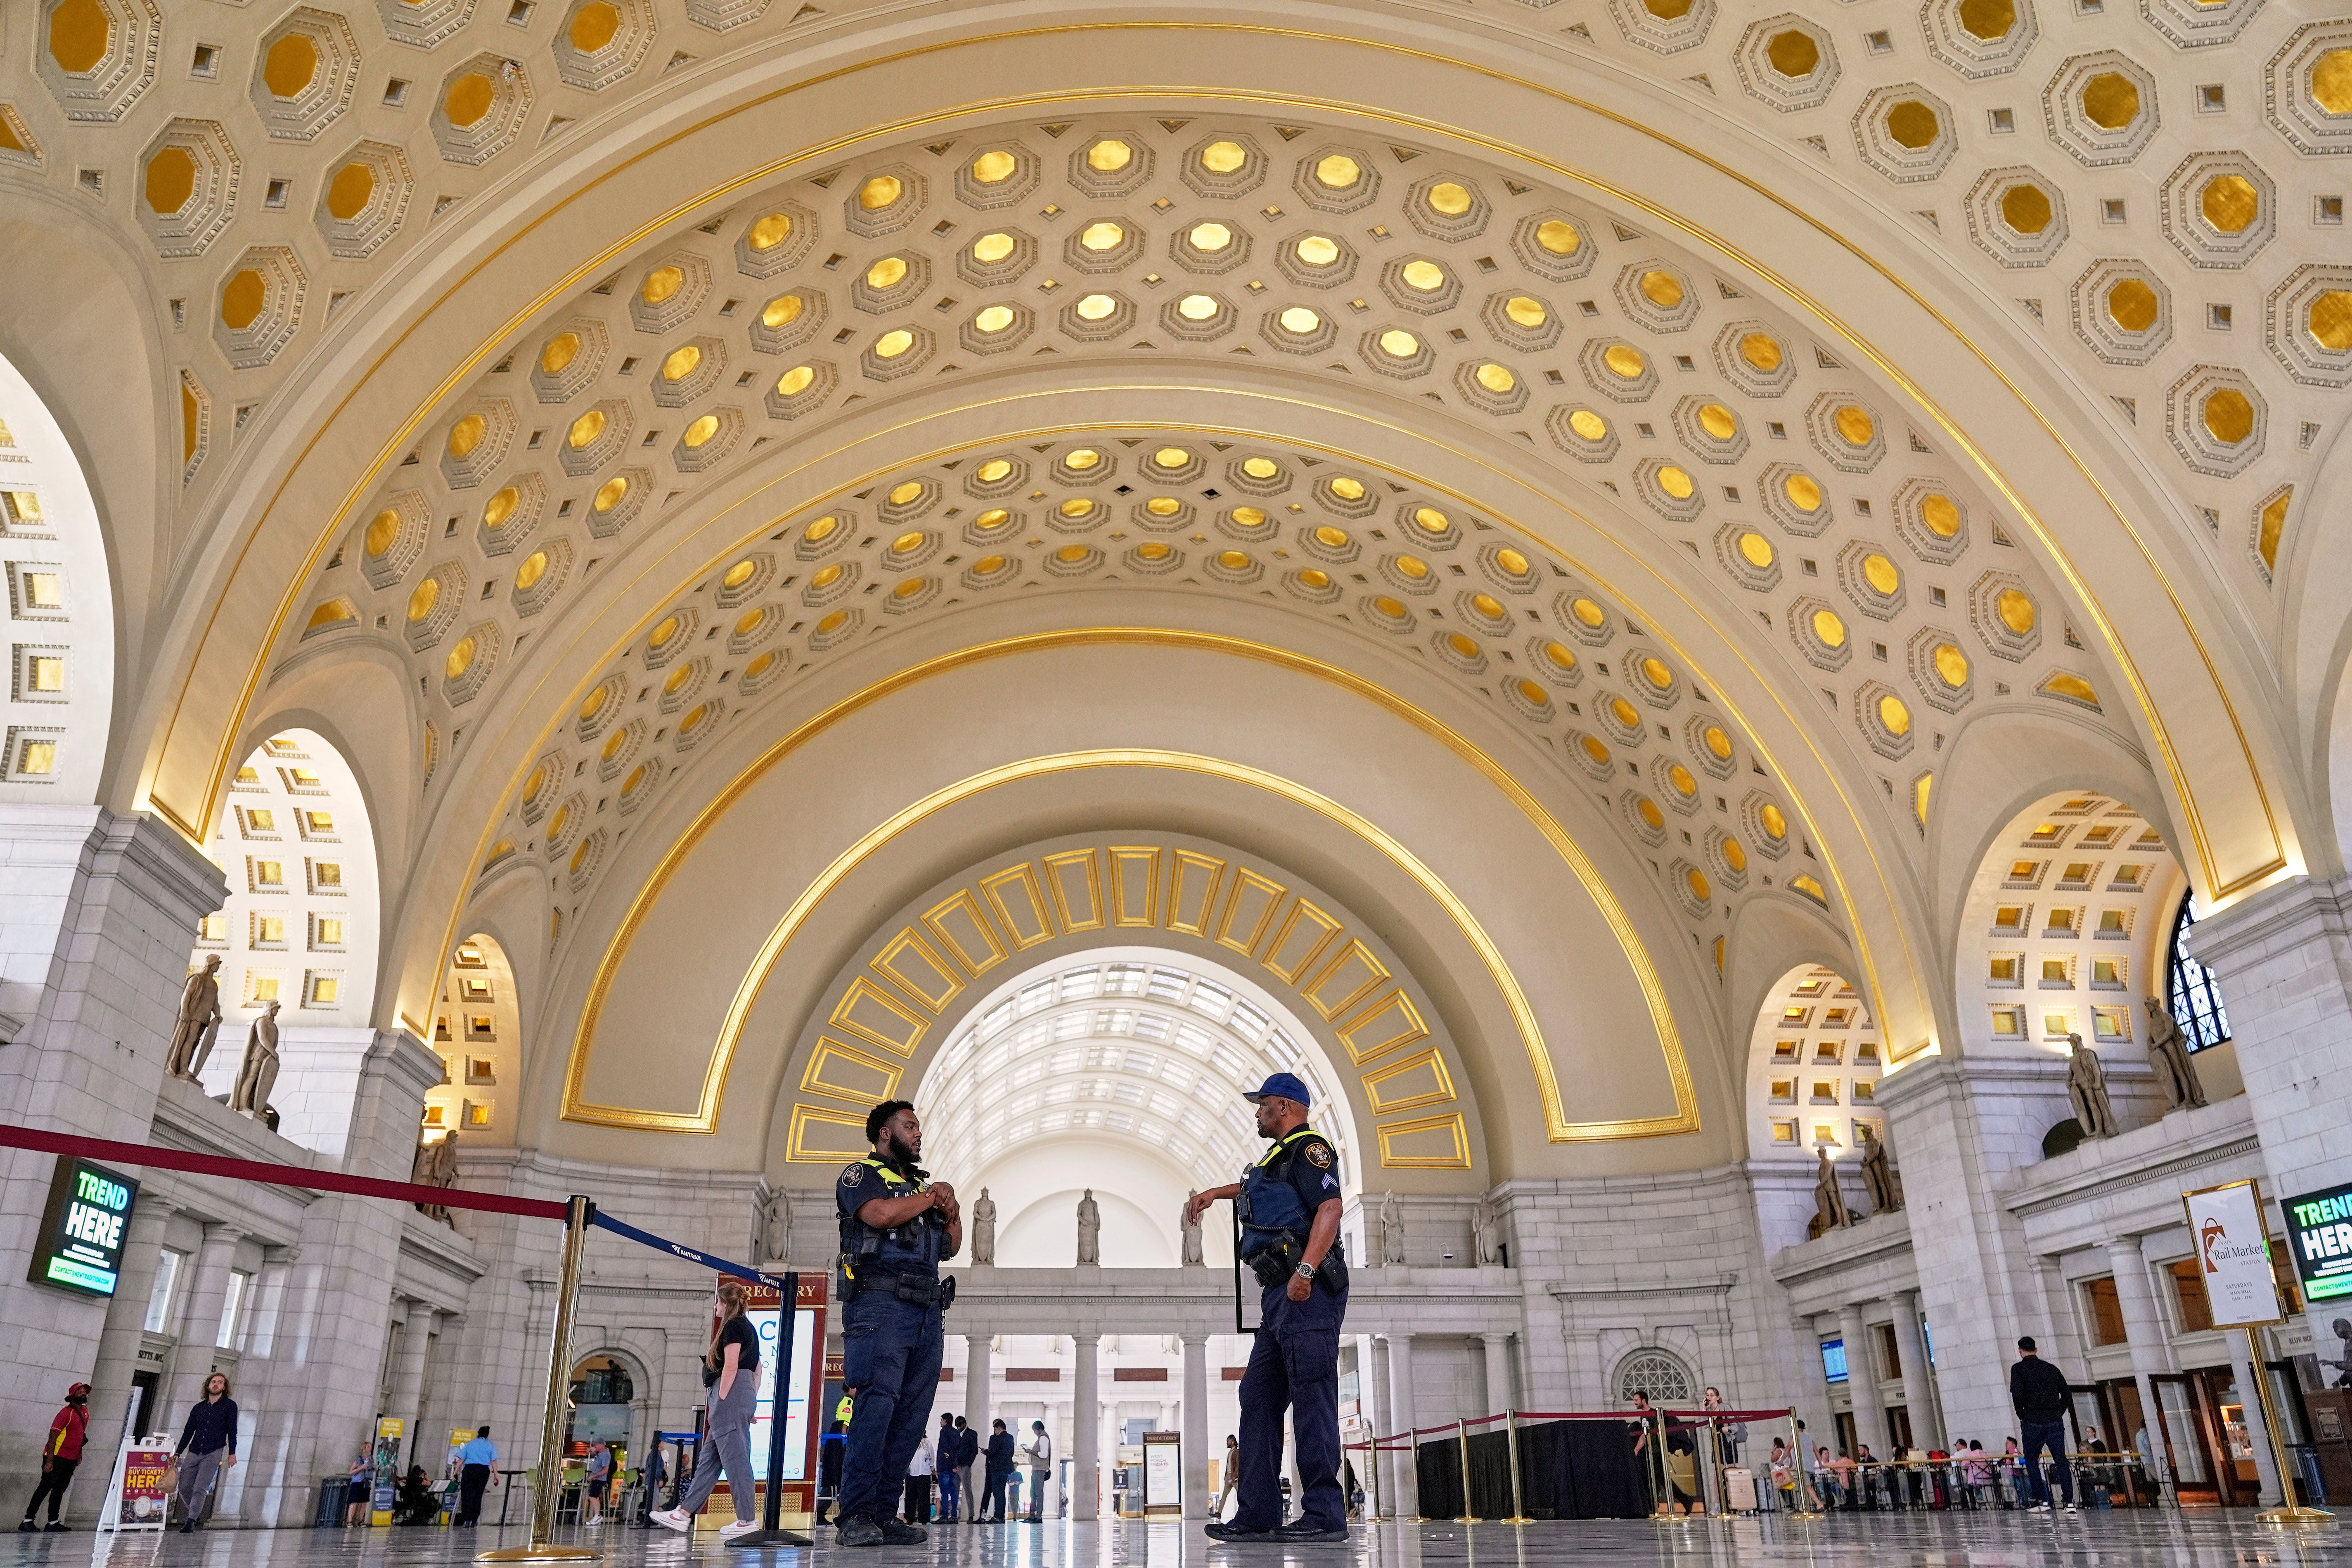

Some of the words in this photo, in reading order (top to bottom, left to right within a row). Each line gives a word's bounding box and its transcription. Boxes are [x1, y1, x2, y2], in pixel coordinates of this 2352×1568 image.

[78, 1171, 128, 1211] TREND
[65, 1201, 123, 1249] HERE
[2301, 1223, 2352, 1260] HER
[680, 1249, 702, 1261] AMTRAK
[2215, 1247, 2230, 1260] Rail
[2231, 1243, 2265, 1258] Market
[764, 1277, 779, 1288] AMTRAK
[2314, 1280, 2352, 1292] CONTACT@NEWT
[743, 1286, 816, 1297] RECRY
[760, 1321, 776, 1341] C
[138, 1350, 154, 1361] SETTS
